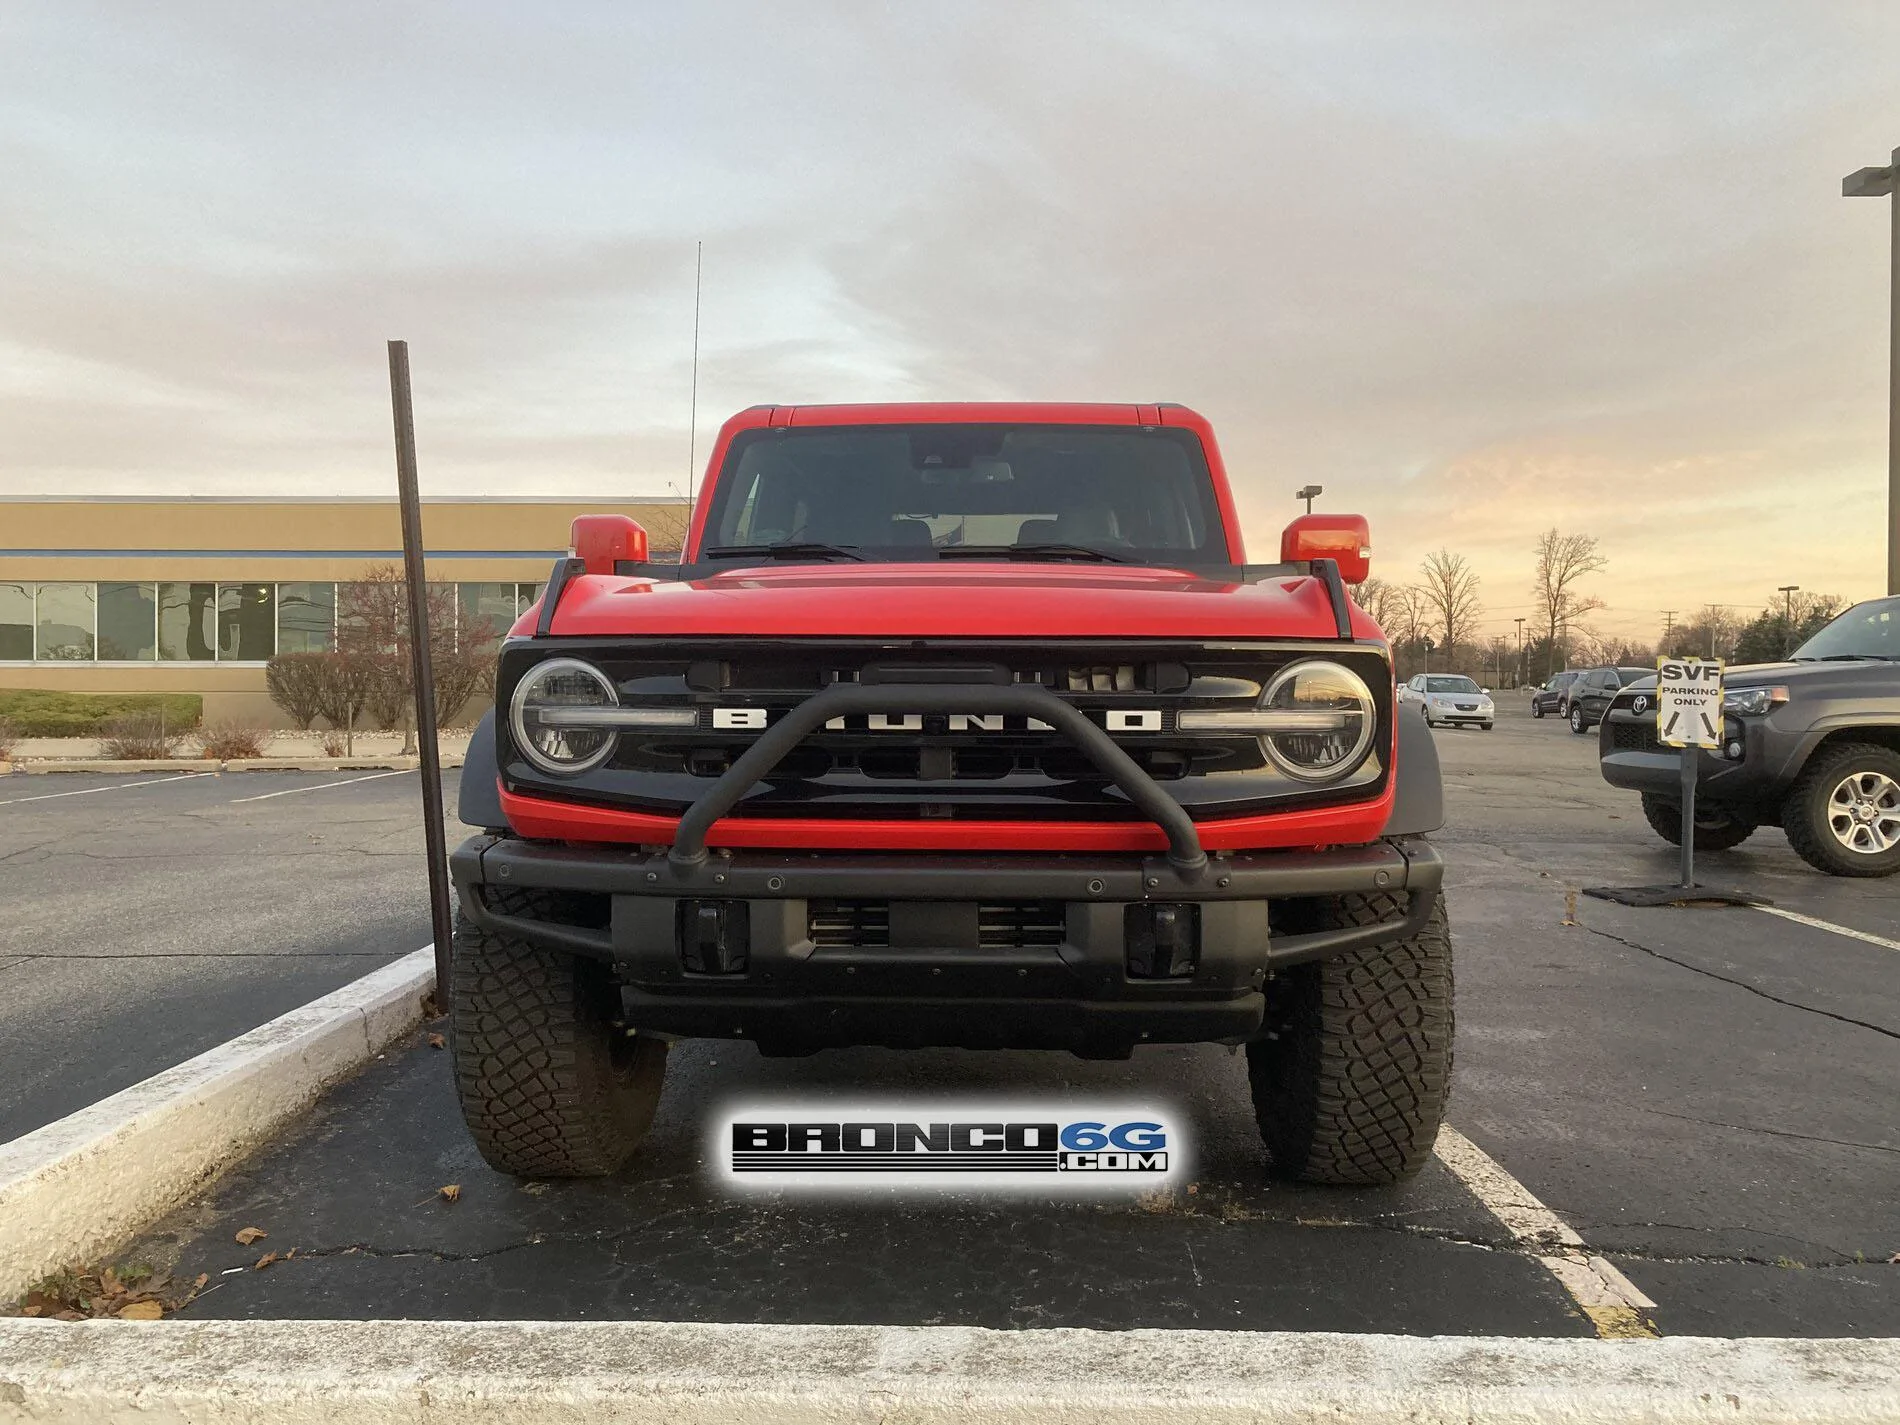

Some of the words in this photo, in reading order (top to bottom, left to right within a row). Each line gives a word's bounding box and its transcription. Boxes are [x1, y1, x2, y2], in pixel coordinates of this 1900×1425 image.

[1662, 664, 1720, 681] SVF
[1662, 687, 1719, 696] PARKING
[1674, 698, 1707, 706] ONLY
[713, 708, 1162, 731] BONO
